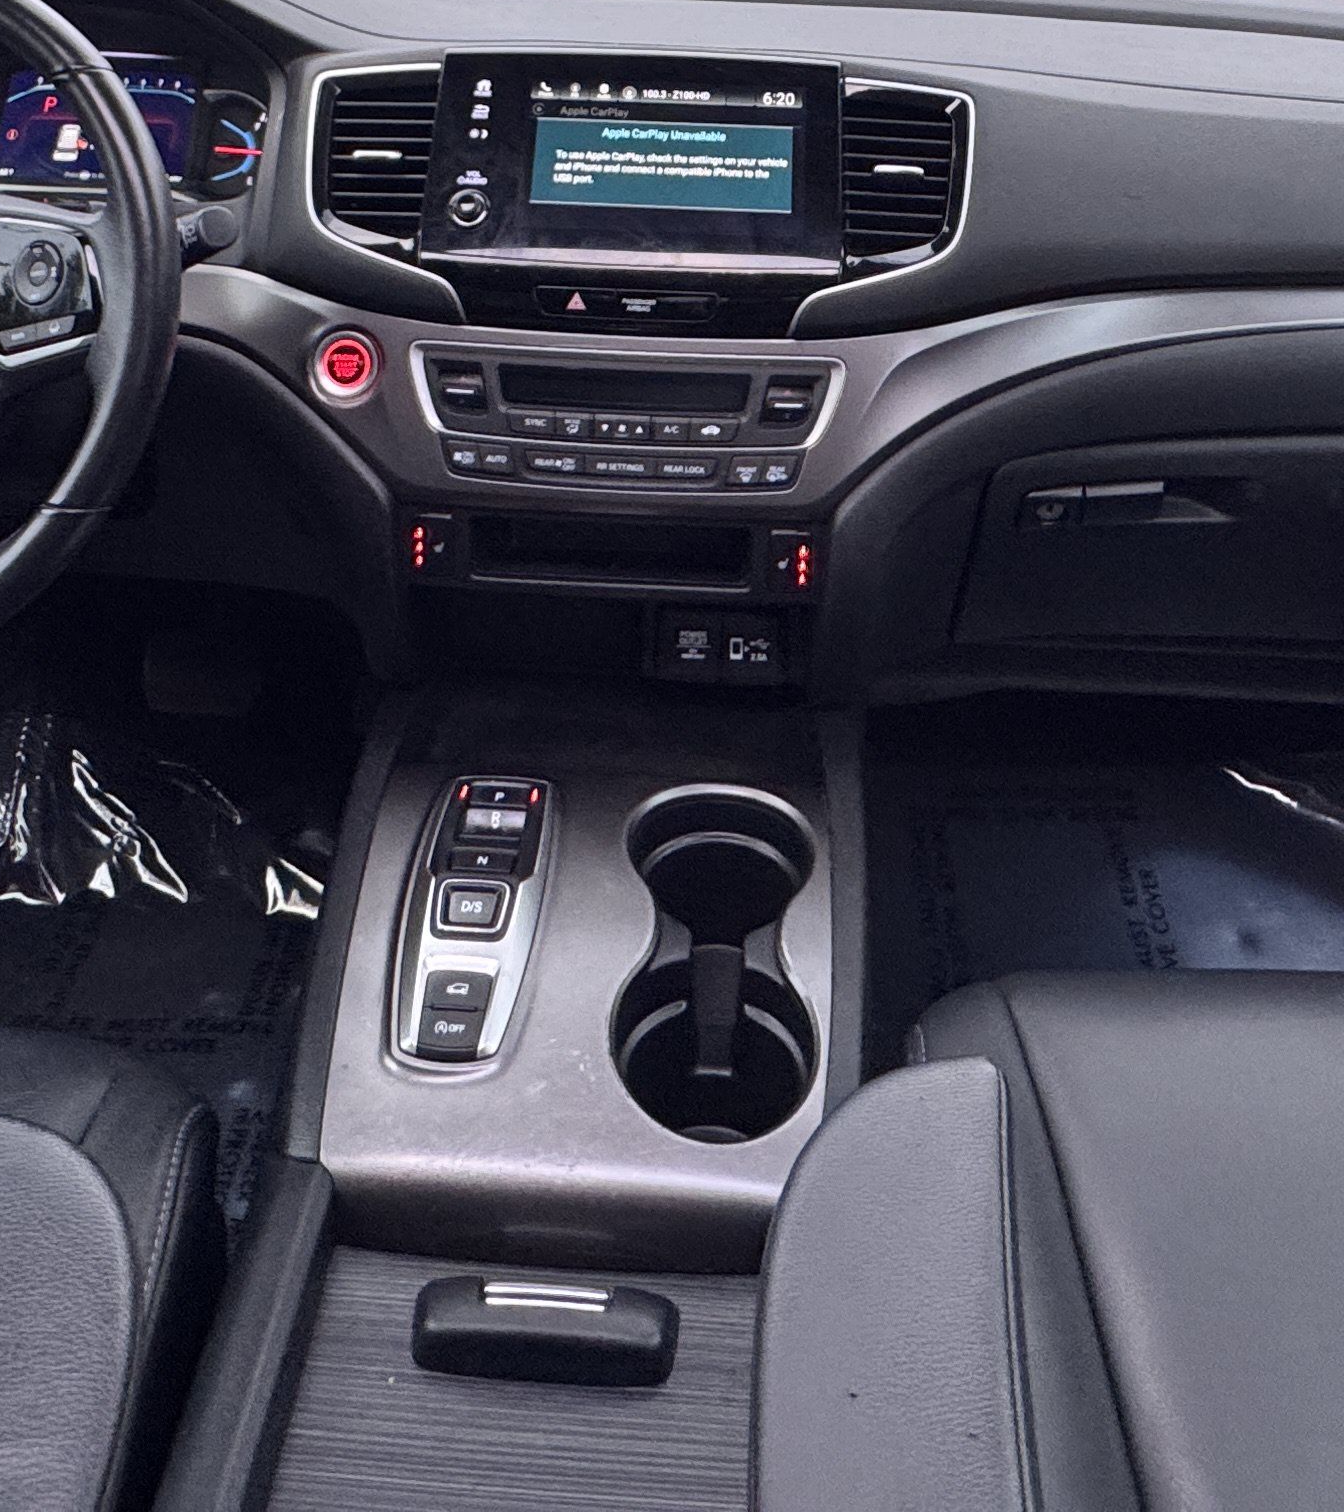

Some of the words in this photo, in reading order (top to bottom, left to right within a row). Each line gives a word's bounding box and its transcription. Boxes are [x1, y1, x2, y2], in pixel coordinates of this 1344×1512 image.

[762, 91, 796, 106] 6:20
[43, 96, 58, 113] P
[560, 105, 589, 116] Apple
[591, 106, 629, 119] CarPlay
[602, 127, 630, 140] Apple
[632, 128, 669, 142] CarPlay
[671, 130, 727, 143] Unavailable
[556, 148, 568, 159] To
[568, 150, 585, 160] use
[586, 150, 611, 162] Apple
[612, 152, 646, 164] CarPlay,
[647, 153, 673, 163] check
[674, 154, 688, 164] the
[689, 155, 723, 167] settings
[724, 157, 737, 166] on
[737, 158, 757, 168] your
[758, 157, 788, 168] vehicle
[554, 162, 572, 171] and
[573, 162, 603, 172] iPhone
[604, 164, 621, 173] and
[622, 166, 656, 175] connect
[664, 167, 712, 178] compatible
[713, 167, 743, 178] iPhone
[744, 169, 754, 178] to
[755, 169, 770, 179] the
[553, 173, 572, 183] USB
[523, 417, 547, 428] SYNC
[664, 425, 680, 434] A/C
[485, 454, 508, 464] AUTO
[534, 458, 556, 467] REAR
[608, 463, 645, 473] SETTINGS
[664, 465, 684, 473] REAR
[684, 466, 705, 475] LOCK
[494, 791, 505, 802] P
[477, 856, 489, 865] N
[460, 900, 483, 914] D/S
[449, 1024, 466, 1033] OFF
